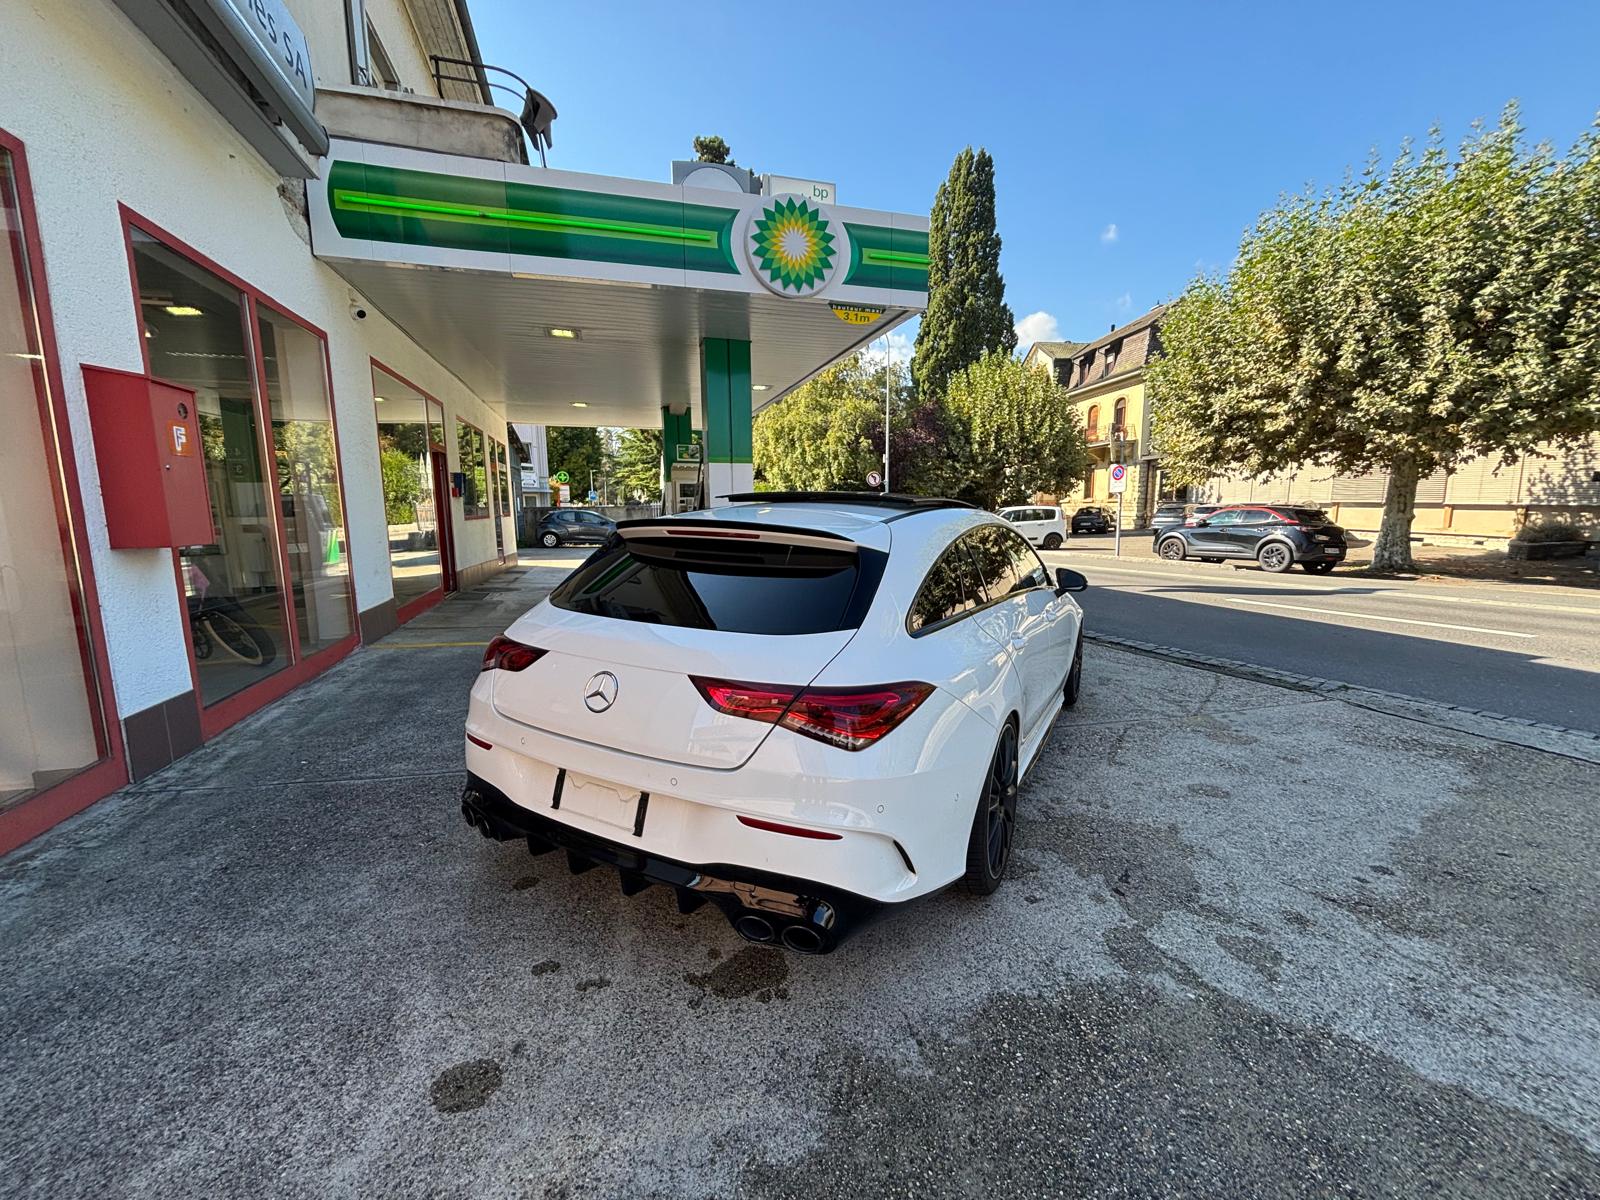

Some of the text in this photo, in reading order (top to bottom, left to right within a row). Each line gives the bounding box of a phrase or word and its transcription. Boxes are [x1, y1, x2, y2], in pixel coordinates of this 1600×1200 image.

[283, 31, 308, 89] SA
[813, 184, 829, 201] bp
[843, 311, 870, 322] 3.1m
[173, 425, 187, 452] F
